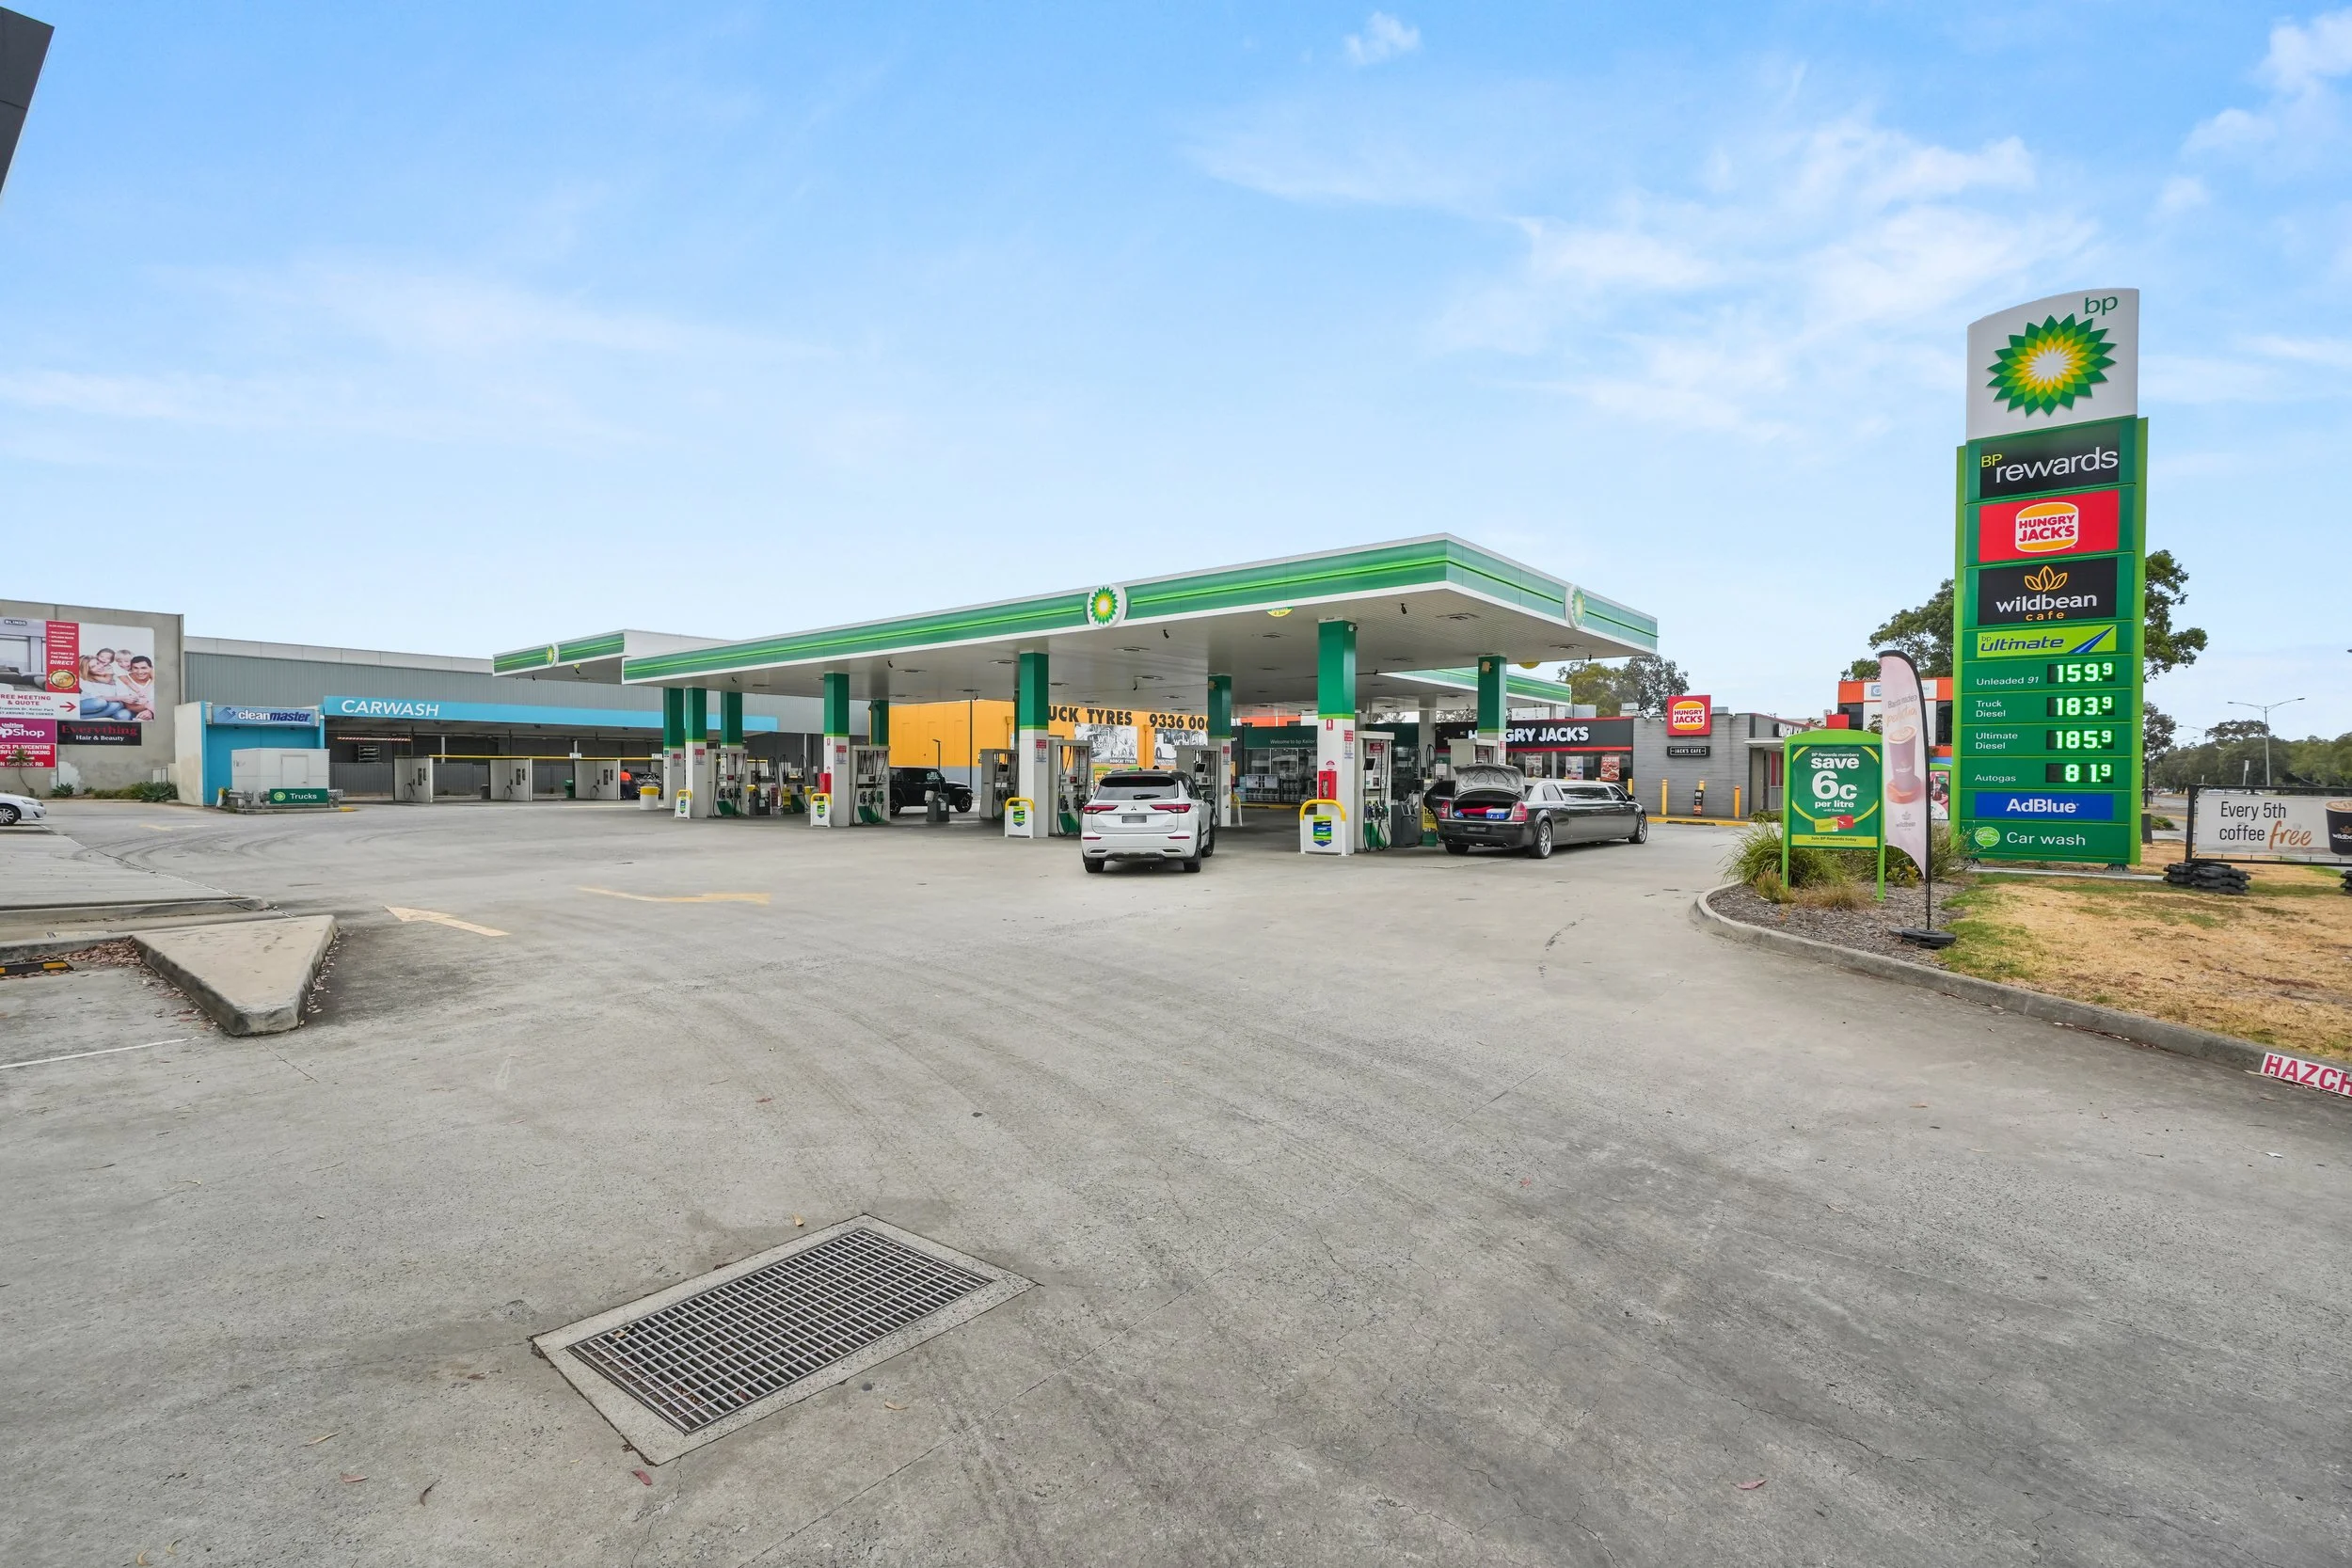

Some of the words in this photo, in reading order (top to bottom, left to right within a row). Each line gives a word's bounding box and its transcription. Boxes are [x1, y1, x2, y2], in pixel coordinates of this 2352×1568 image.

[2084, 296, 2119, 316] bp
[1980, 453, 2003, 467] BP
[1995, 446, 2119, 483] rewards
[2018, 515, 2075, 530] HUNGRY
[2018, 525, 2075, 543] JACK'S
[1995, 594, 2098, 613] wildbean
[2025, 610, 2065, 622] cafe
[1980, 636, 2065, 652] ultimate
[1977, 676, 2024, 686] Unleaded
[2026, 675, 2040, 684] 91
[238, 709, 311, 723] cleanmaster
[341, 699, 441, 718] CARWASH
[1087, 708, 1133, 726] TYRES
[1149, 713, 1184, 729] 9336
[1188, 715, 1209, 731] 00
[1674, 715, 1703, 723] JACK'S
[61, 724, 138, 736] Everything
[1468, 727, 1537, 743] HGRY
[1538, 726, 1590, 742] JACK'S
[1976, 732, 2018, 740] Ultimate
[1810, 757, 1860, 769] save
[1975, 774, 2017, 784] Autogas
[1814, 800, 1832, 809] per
[1834, 800, 1854, 808] litre
[2006, 798, 2077, 814] AdBlue
[2220, 800, 2260, 821] Every
[2263, 802, 2287, 818] 5th
[2006, 832, 2036, 844] Car
[2040, 833, 2087, 846] wash
[2219, 824, 2265, 841] coffee
[2268, 820, 2312, 850] free
